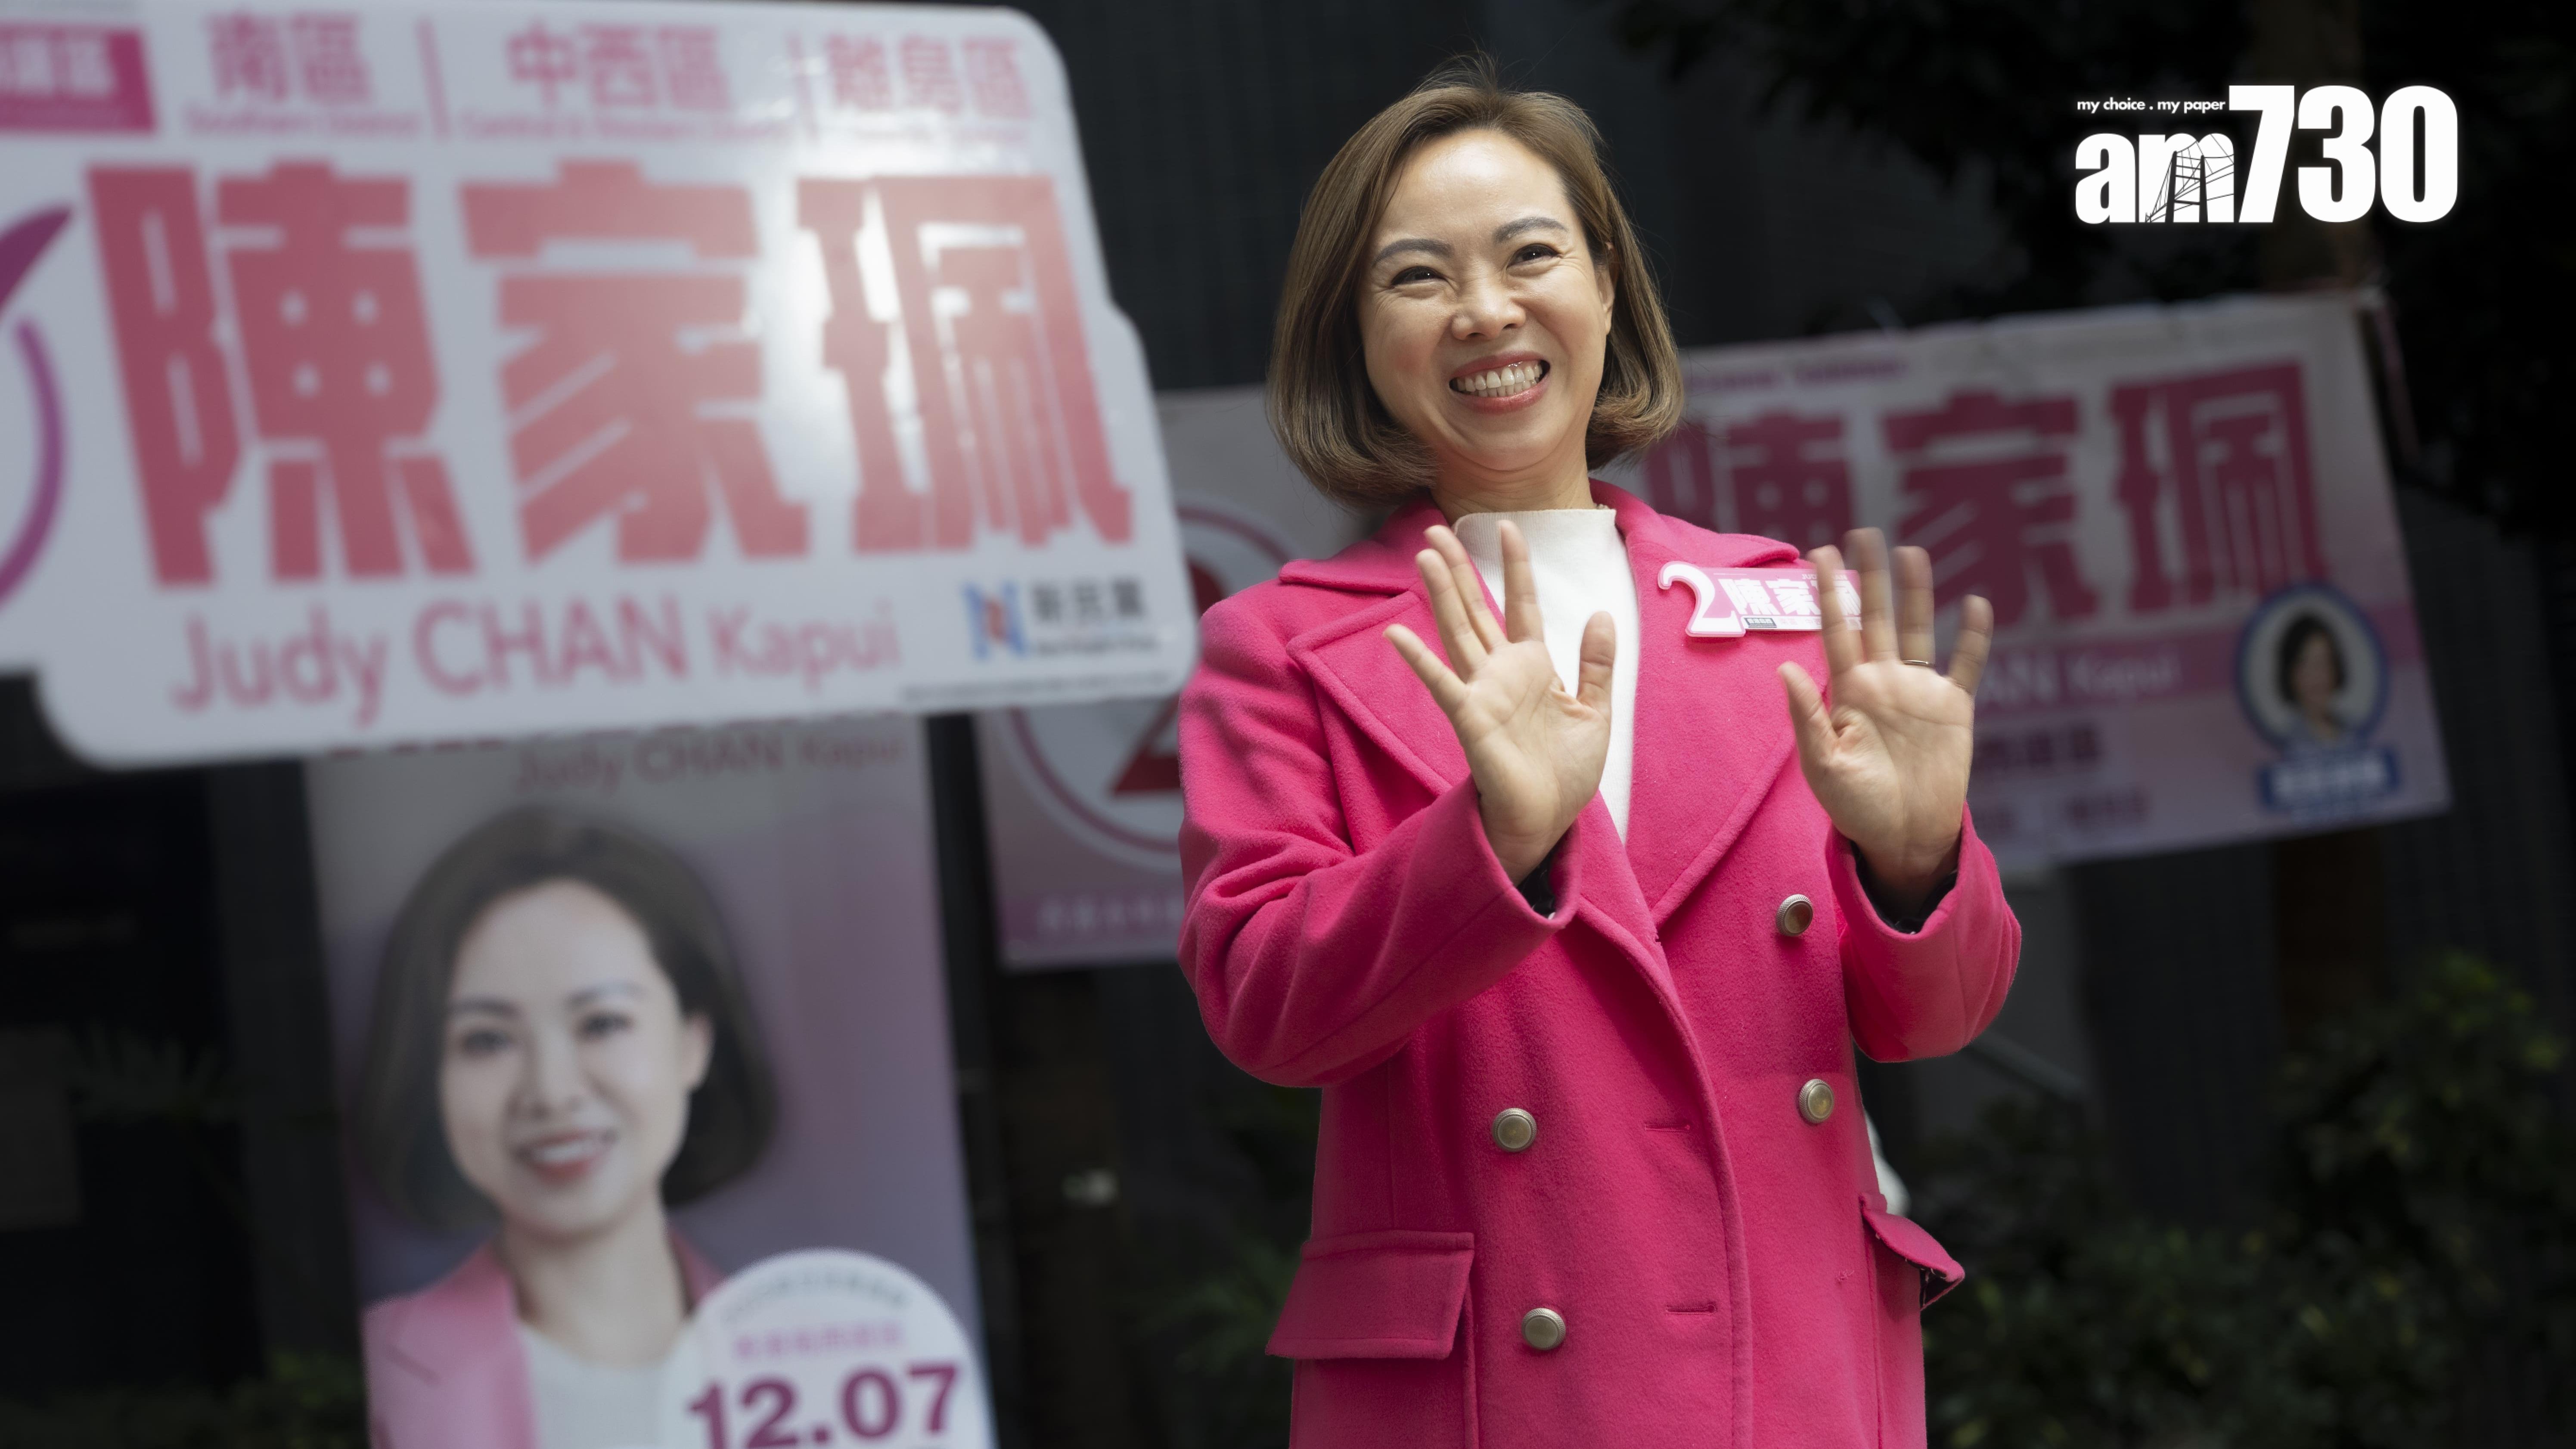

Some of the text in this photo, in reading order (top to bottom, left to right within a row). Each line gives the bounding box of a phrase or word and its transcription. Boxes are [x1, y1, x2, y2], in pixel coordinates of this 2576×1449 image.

[206, 9, 373, 103] 南區
[506, 16, 732, 113] 中西區
[86, 158, 1135, 590] 陳家珮
[1659, 562, 1743, 636] 2
[170, 592, 903, 729] Judy CHAN Kapui
[513, 744, 624, 796] Judy
[630, 731, 785, 784] CHAN
[688, 1362, 959, 1449] 12.07
